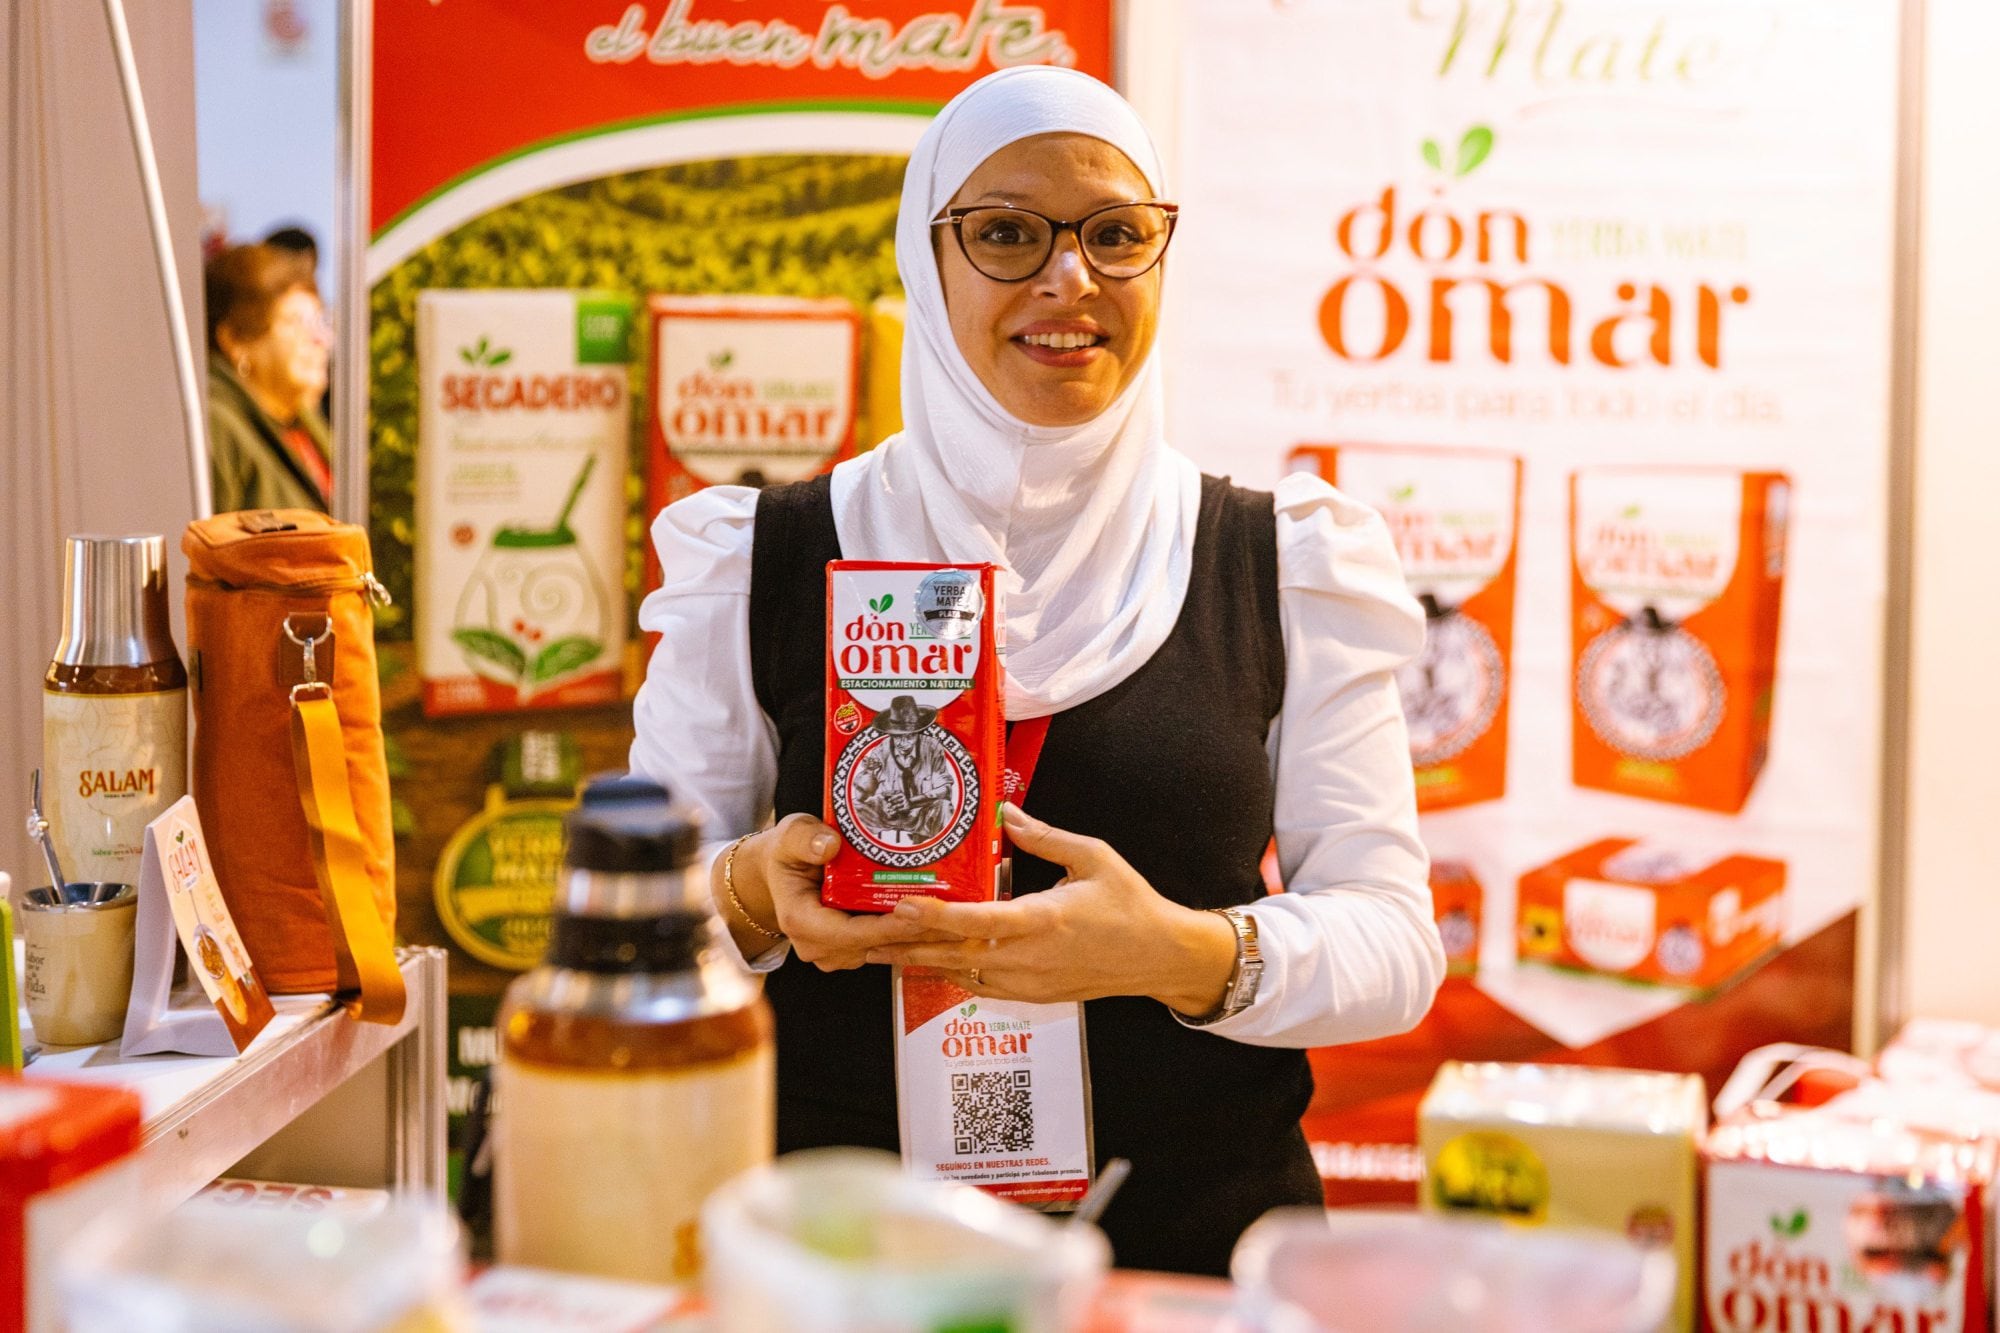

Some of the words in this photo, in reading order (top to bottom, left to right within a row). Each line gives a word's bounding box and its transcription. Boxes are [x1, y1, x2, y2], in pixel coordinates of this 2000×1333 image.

[1336, 184, 1530, 264] don
[1317, 272, 1751, 370] omar
[441, 373, 620, 413] SECADERO
[673, 405, 835, 439] omar
[934, 585, 966, 596] YERBA
[845, 615, 905, 641] don
[840, 644, 973, 674] omar
[841, 680, 927, 689] ESTACIONAMIENTO
[929, 680, 972, 689] NATURAL
[79, 768, 154, 798] SALAM
[944, 1017, 986, 1036] don
[989, 1022, 1011, 1032] YERBA
[1012, 1020, 1031, 1030] MATE
[942, 1032, 1033, 1058] omar
[973, 1161, 984, 1170] EN
[985, 1159, 1024, 1169] NUESTRAS
[1728, 1240, 1830, 1289] don
